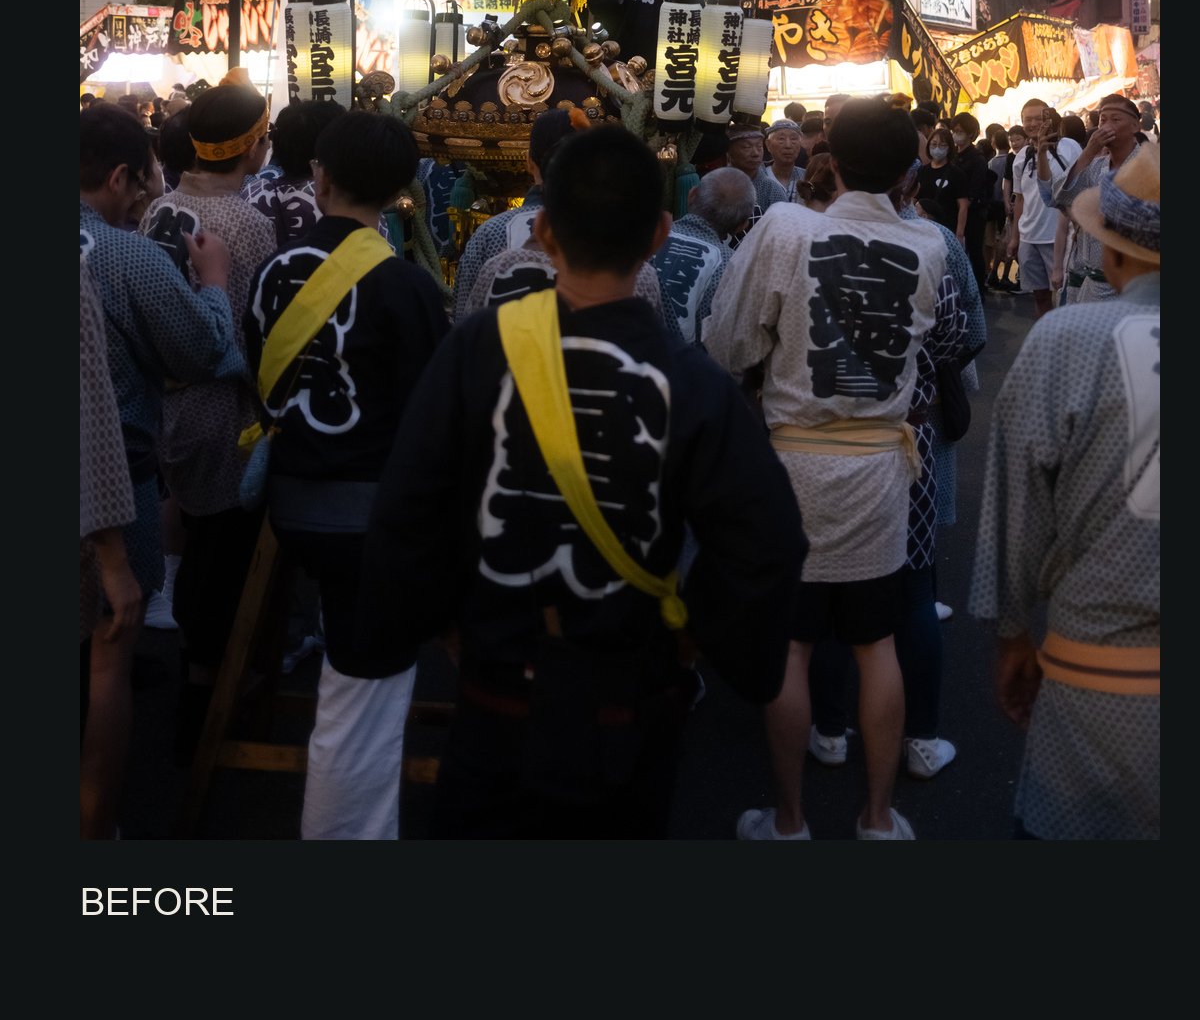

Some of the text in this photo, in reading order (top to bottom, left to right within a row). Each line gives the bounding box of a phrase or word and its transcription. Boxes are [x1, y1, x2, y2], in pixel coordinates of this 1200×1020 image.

[314, 9, 333, 45] 長崎
[667, 8, 688, 44] 神社
[721, 11, 741, 47] 神社
[661, 44, 699, 114] 宮元
